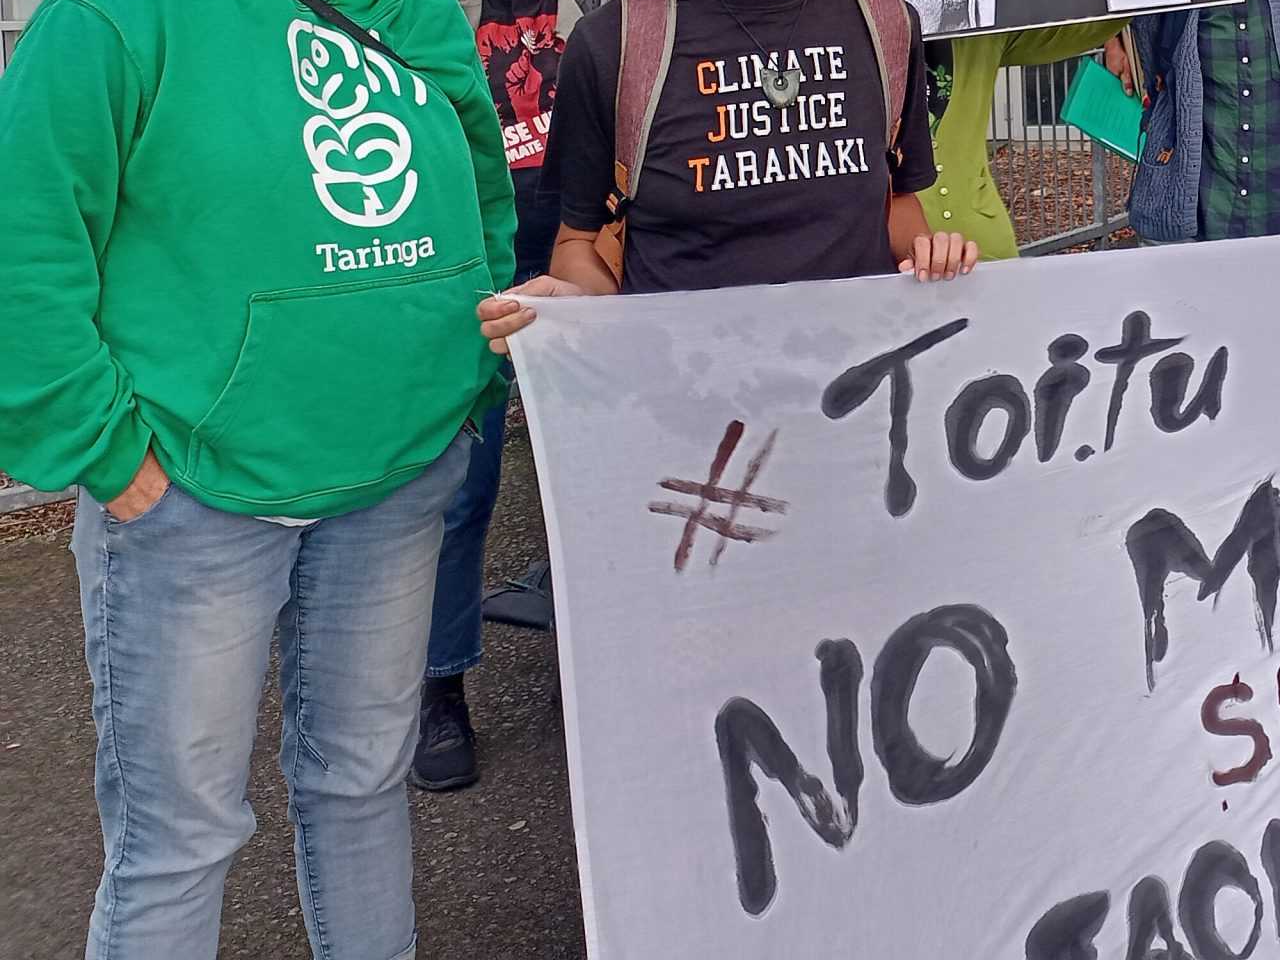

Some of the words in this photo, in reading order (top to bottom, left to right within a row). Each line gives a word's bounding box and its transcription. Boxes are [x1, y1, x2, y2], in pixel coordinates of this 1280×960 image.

[697, 46, 847, 95] CLIMATE
[708, 92, 847, 142] JUSTICE
[688, 138, 870, 192] TARANAKI
[316, 236, 435, 273] Taringa
[714, 603, 1018, 918] NO
